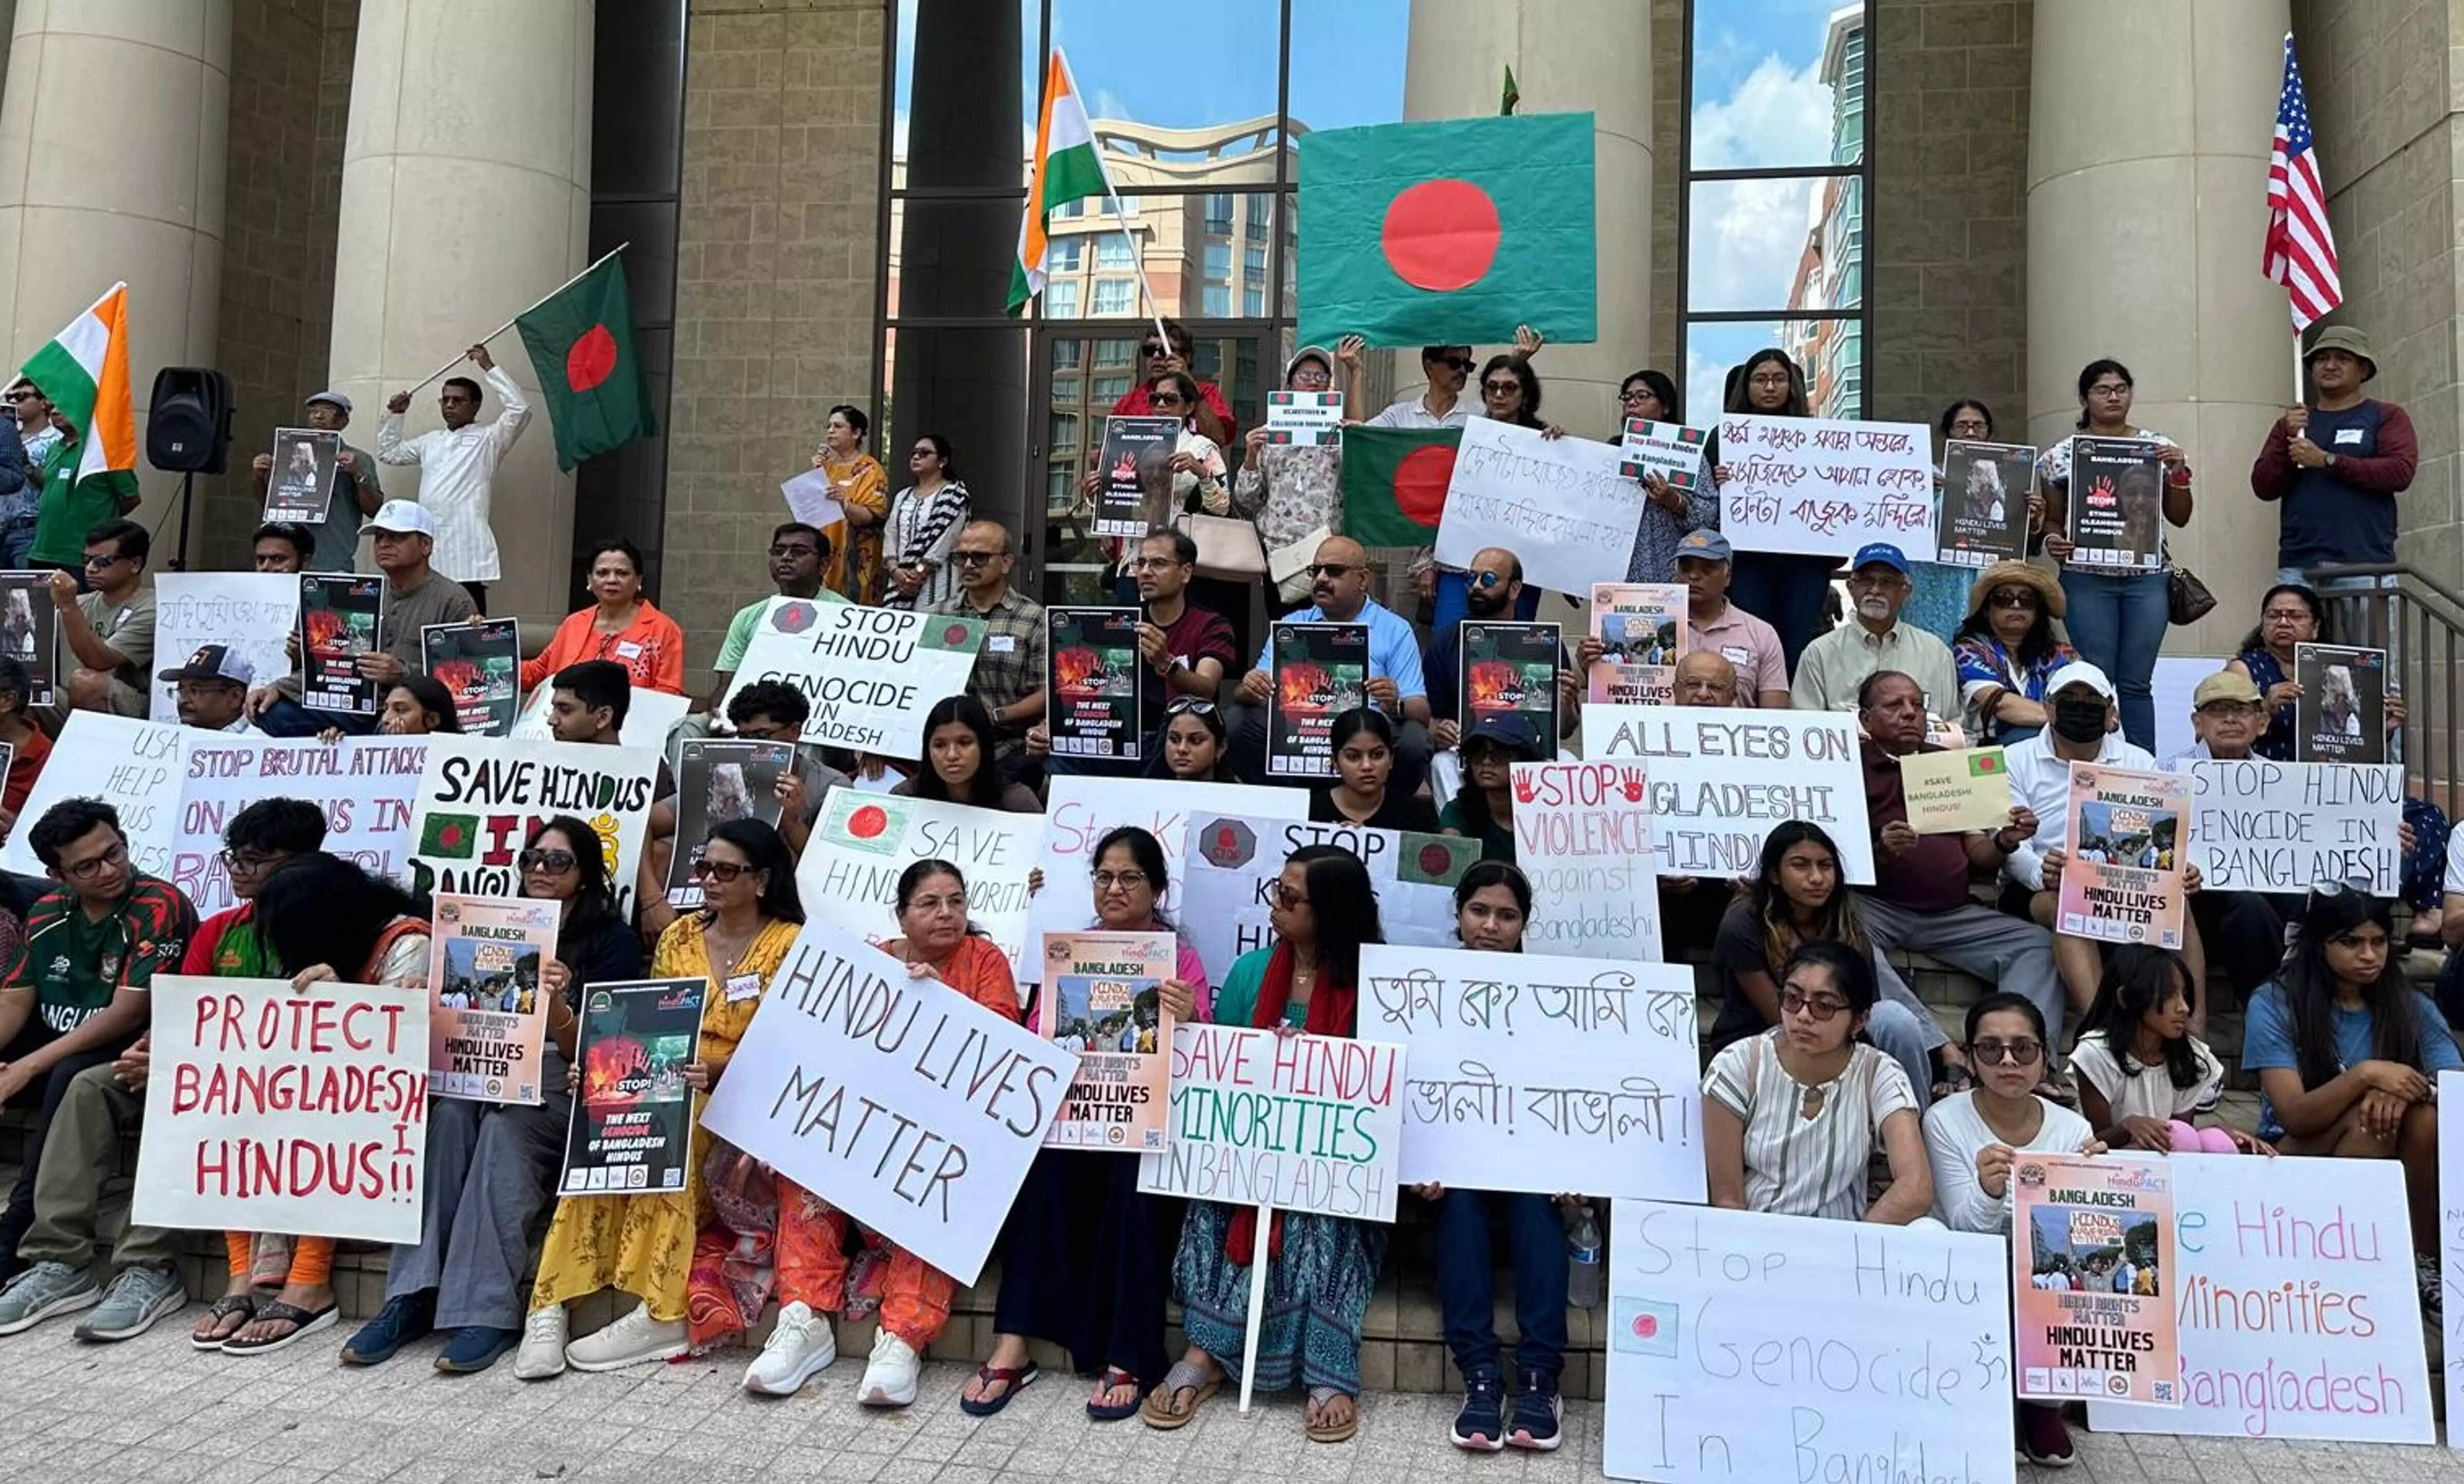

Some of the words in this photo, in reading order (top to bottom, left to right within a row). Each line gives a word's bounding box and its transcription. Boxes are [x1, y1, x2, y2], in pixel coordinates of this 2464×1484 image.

[835, 607, 916, 636] STOP
[811, 631, 915, 664] HINDU
[1607, 684, 1638, 697] HINDU
[1640, 686, 1672, 698] LIVES
[813, 702, 841, 721] IN
[132, 727, 179, 762] USA
[1606, 721, 1691, 759] ALL
[1696, 722, 1791, 761] EYES
[1802, 725, 1851, 762] ON
[104, 764, 168, 796] HELP
[188, 747, 254, 779] STOP
[259, 747, 344, 777] BRUTAL
[434, 756, 535, 805] SAVE
[539, 764, 651, 812] HINDUS
[1541, 764, 1617, 807] STOP
[2097, 791, 2163, 808] BANGLADESH
[2191, 760, 2283, 800] STOP
[2304, 764, 2403, 806] HINDU
[184, 799, 226, 834] ON
[369, 799, 415, 832] IN
[1515, 809, 1654, 856] VIOLENCE
[2336, 818, 2378, 844] IN
[910, 820, 1014, 867] SAVE
[1528, 859, 1637, 907] against
[2209, 846, 2392, 892] BANGLADESH
[2084, 886, 2124, 905] HINDU
[2127, 893, 2167, 910] LIVES
[2093, 903, 2152, 924] MATTER
[461, 925, 526, 941] BANGLADESH
[1526, 901, 1653, 949] Bangladeshi
[1073, 962, 1145, 976] BANGLADESH
[1369, 968, 1445, 1035] তুমি
[1459, 979, 1519, 1037] কে?
[1527, 970, 1636, 1035] আমি
[195, 993, 405, 1055] PROTECT
[445, 1039, 482, 1056] HINDU
[485, 1043, 524, 1061] LIVES
[780, 944, 923, 1054] HINDU
[914, 1013, 1058, 1139] LIVES
[452, 1056, 509, 1077] MATTER
[1171, 1027, 1261, 1085] SAVE
[1272, 1037, 1397, 1106] HINDU
[617, 1078, 652, 1092] STOP!
[1106, 1085, 1149, 1103] LIVES
[605, 1114, 625, 1125] THE
[625, 1112, 651, 1124] NEXT
[1069, 1103, 1133, 1123] MATTER
[1169, 1086, 1377, 1164] MINORITIES
[588, 1141, 601, 1152] OF
[602, 1137, 666, 1151] BANGLADESH
[606, 1151, 643, 1163] HINDUS
[769, 1064, 969, 1224] MATTER
[195, 1137, 414, 1204] HINDUS!!
[1196, 1143, 1385, 1217] BANGLADESH
[2049, 1189, 2136, 1209] BANGLADESH
[2234, 1199, 2382, 1262] Hindu
[1637, 1209, 1786, 1282] Stop
[1853, 1233, 1981, 1307] Hindu
[1695, 1295, 1962, 1406] Genocide
[2046, 1326, 2096, 1348] HINDU
[2101, 1330, 2154, 1352] LIVES
[2060, 1348, 2136, 1373] MATTER
[1653, 1394, 1732, 1475] In
